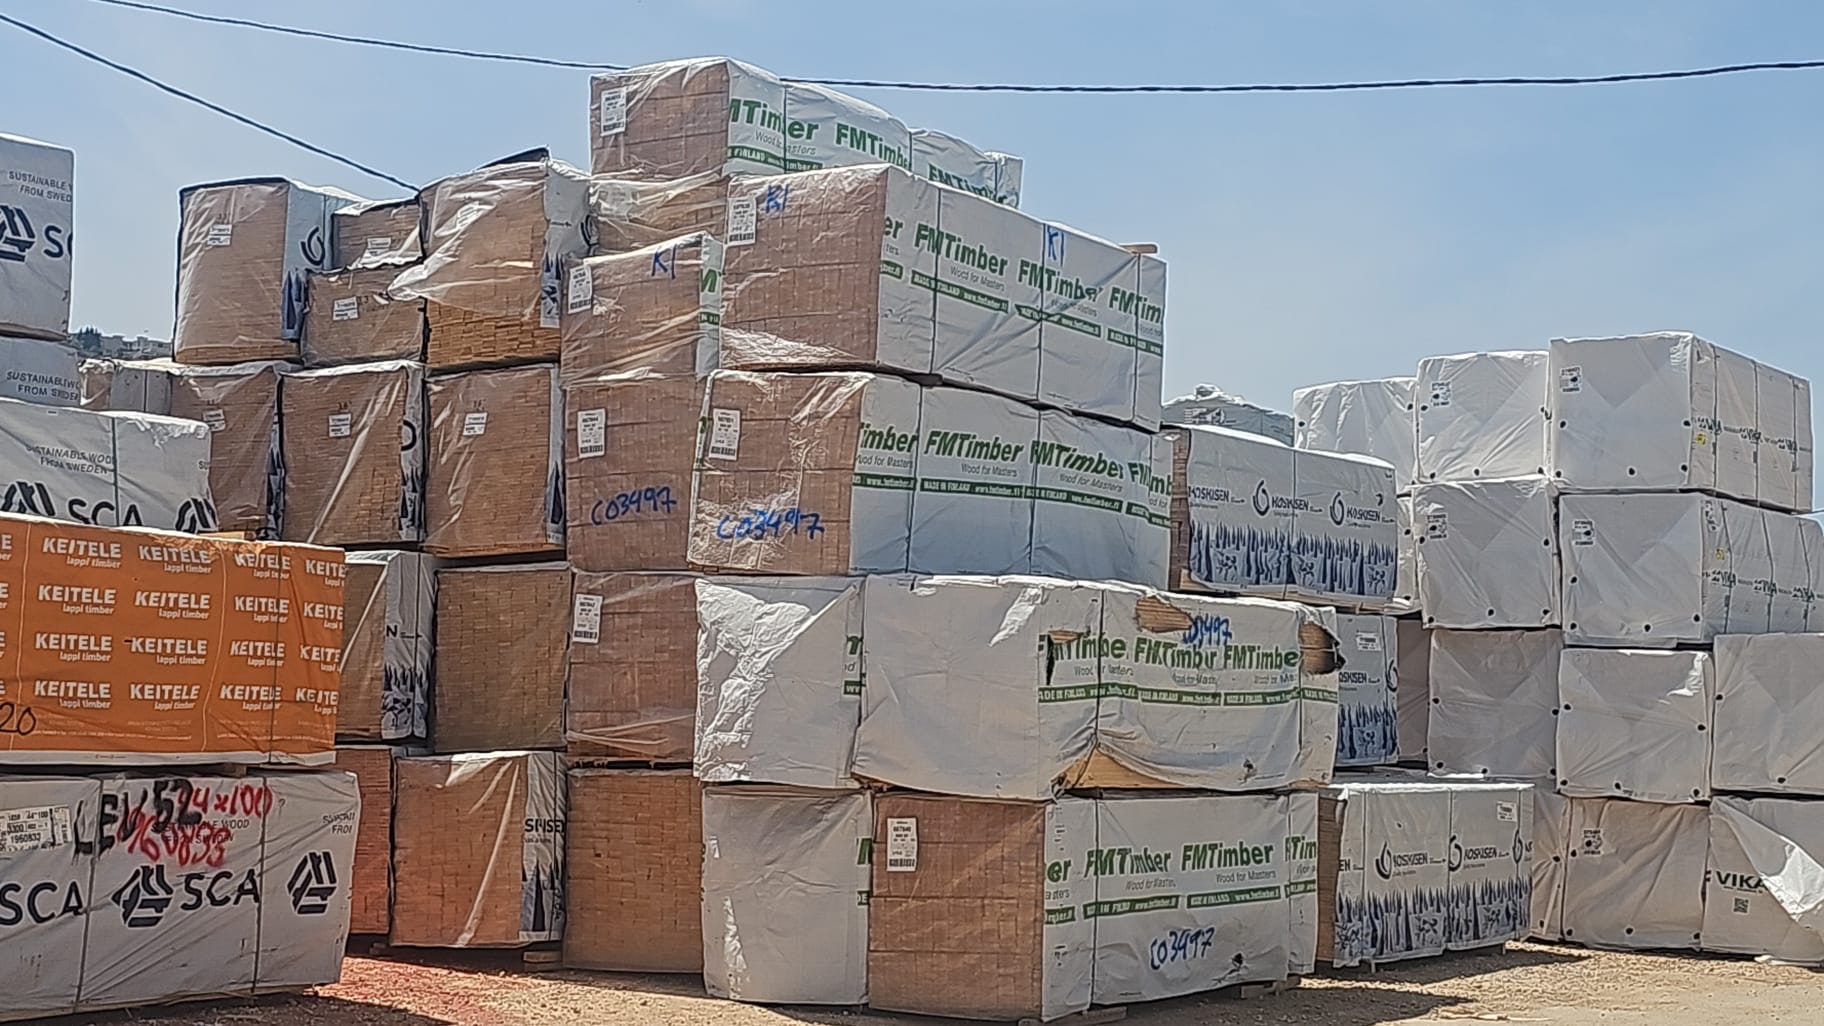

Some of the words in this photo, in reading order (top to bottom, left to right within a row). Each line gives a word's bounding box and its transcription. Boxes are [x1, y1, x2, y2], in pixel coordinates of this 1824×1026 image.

[9, 171, 66, 190] SUSTAINABLE
[20, 185, 44, 197] FROM
[914, 223, 1007, 276] FMTimber
[18, 384, 47, 396] FROM
[924, 430, 1024, 463] FMTimber
[961, 463, 980, 473] Wood
[1030, 440, 1125, 480] FMTimber
[68, 498, 143, 527] SCA
[591, 486, 677, 525] C03497
[1272, 496, 1309, 513] KOSKISEN
[716, 508, 825, 540] C03497
[1347, 508, 1380, 522] KOSKISEN
[43, 537, 121, 558] KEITELE
[139, 546, 211, 565] KEITELE
[39, 585, 116, 605] KEITELE
[135, 591, 210, 610] KEITELE
[36, 633, 112, 651] KEITELE
[131, 637, 207, 655] KEITELE
[35, 681, 111, 699] KEITELE
[130, 684, 200, 701] KEITELE
[1084, 847, 1171, 878] FMTimber
[1181, 841, 1274, 871] FMTimber
[1047, 860, 1071, 882] er
[181, 870, 261, 911] SCA
[0, 882, 83, 927] SCA
[1150, 926, 1215, 971] C03497
